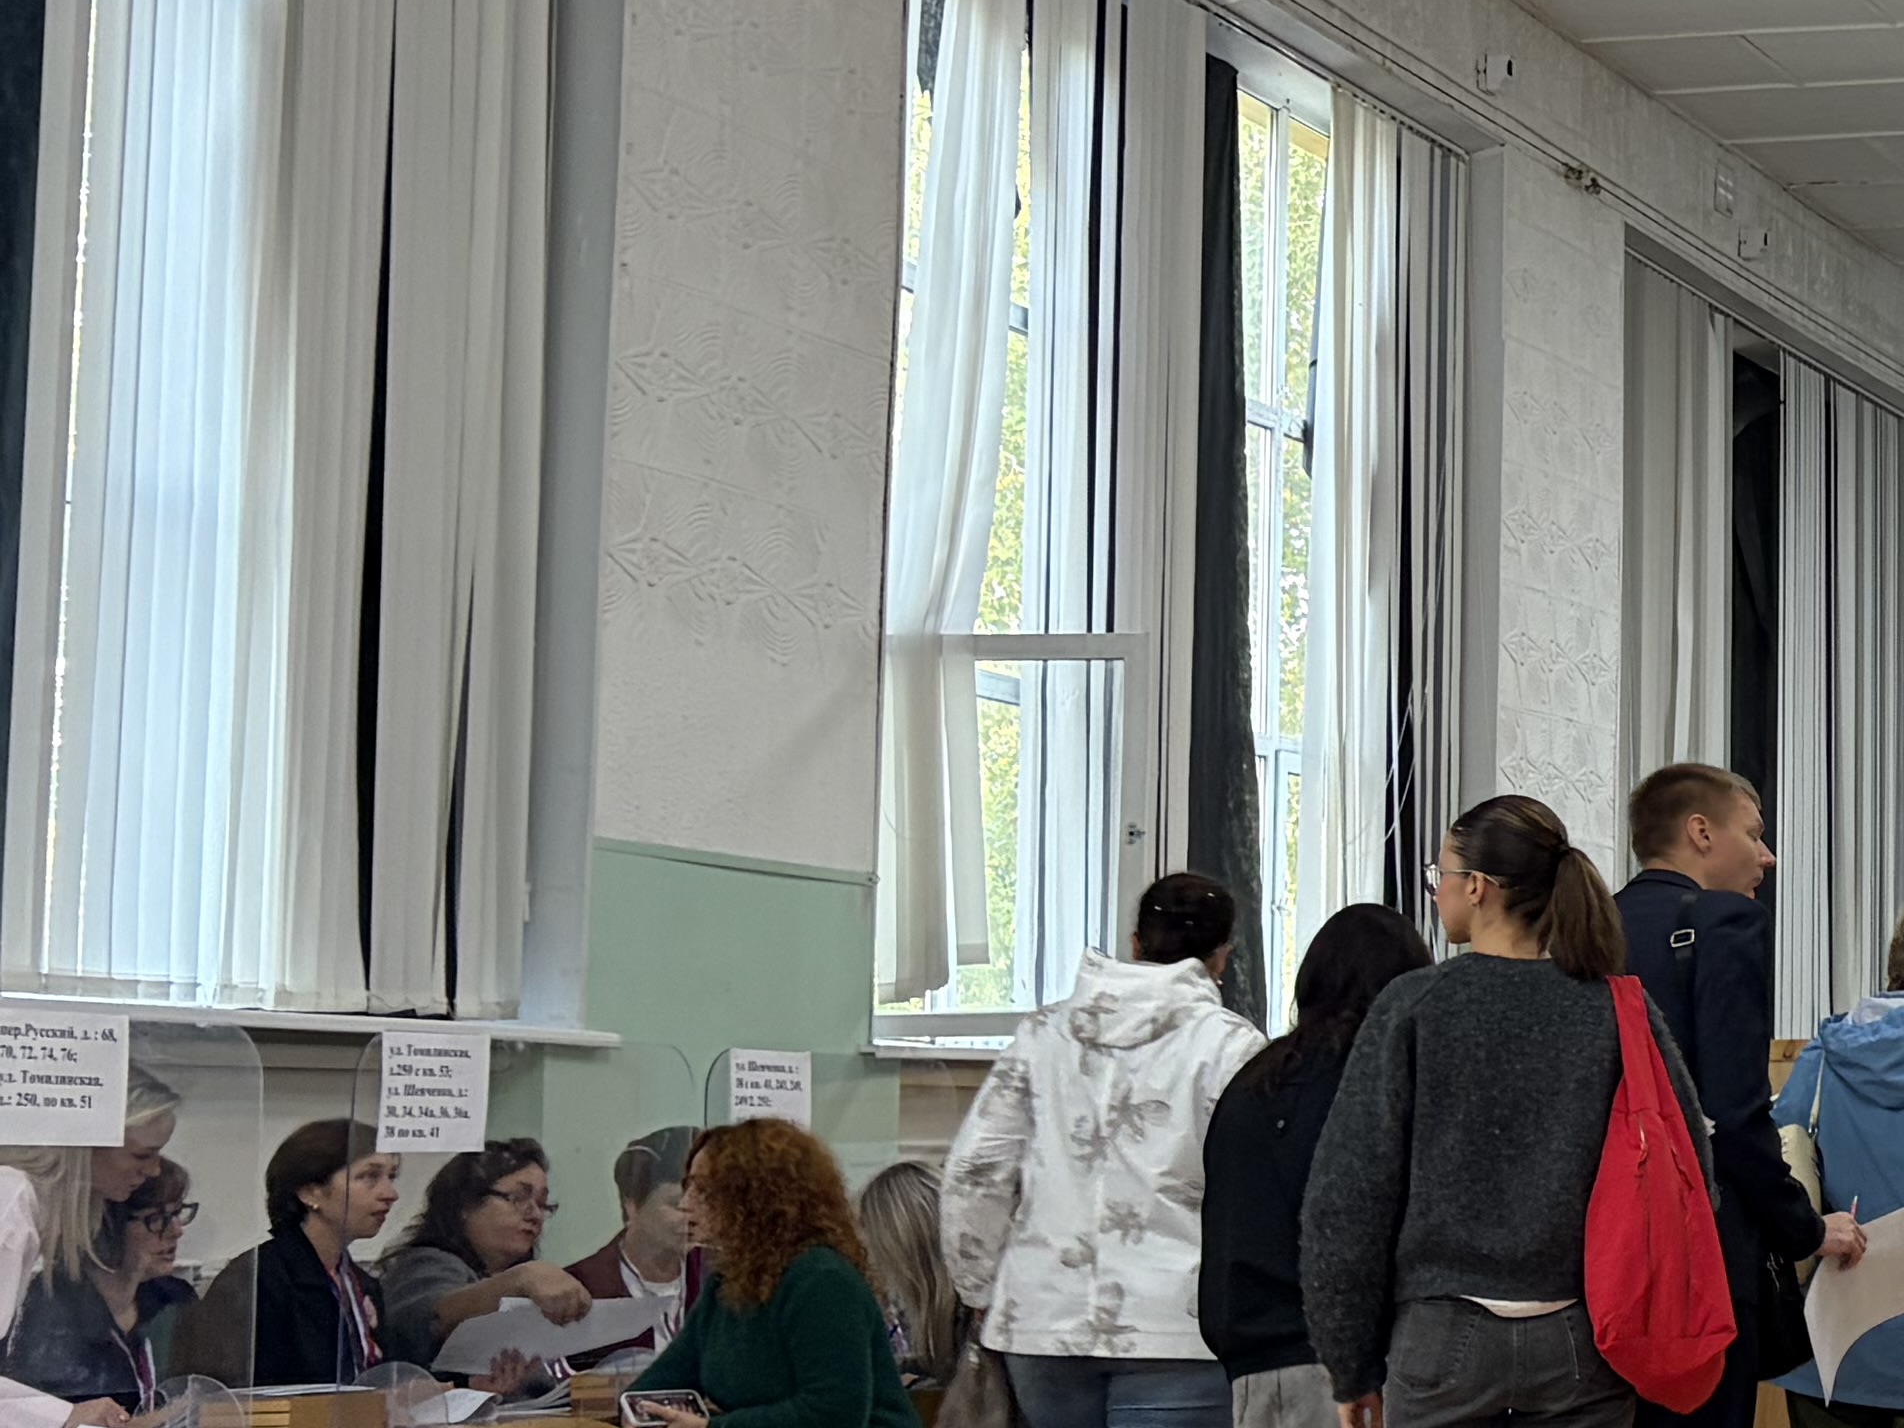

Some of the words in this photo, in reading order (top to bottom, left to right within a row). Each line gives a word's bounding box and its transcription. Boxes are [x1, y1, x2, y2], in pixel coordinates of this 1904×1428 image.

[20, 1046, 37, 1060] 72,
[40, 1046, 58, 1061] 74,
[16, 1092, 40, 1107] 250,
[44, 1097, 58, 1107] по
[80, 1096, 92, 1108] 51
